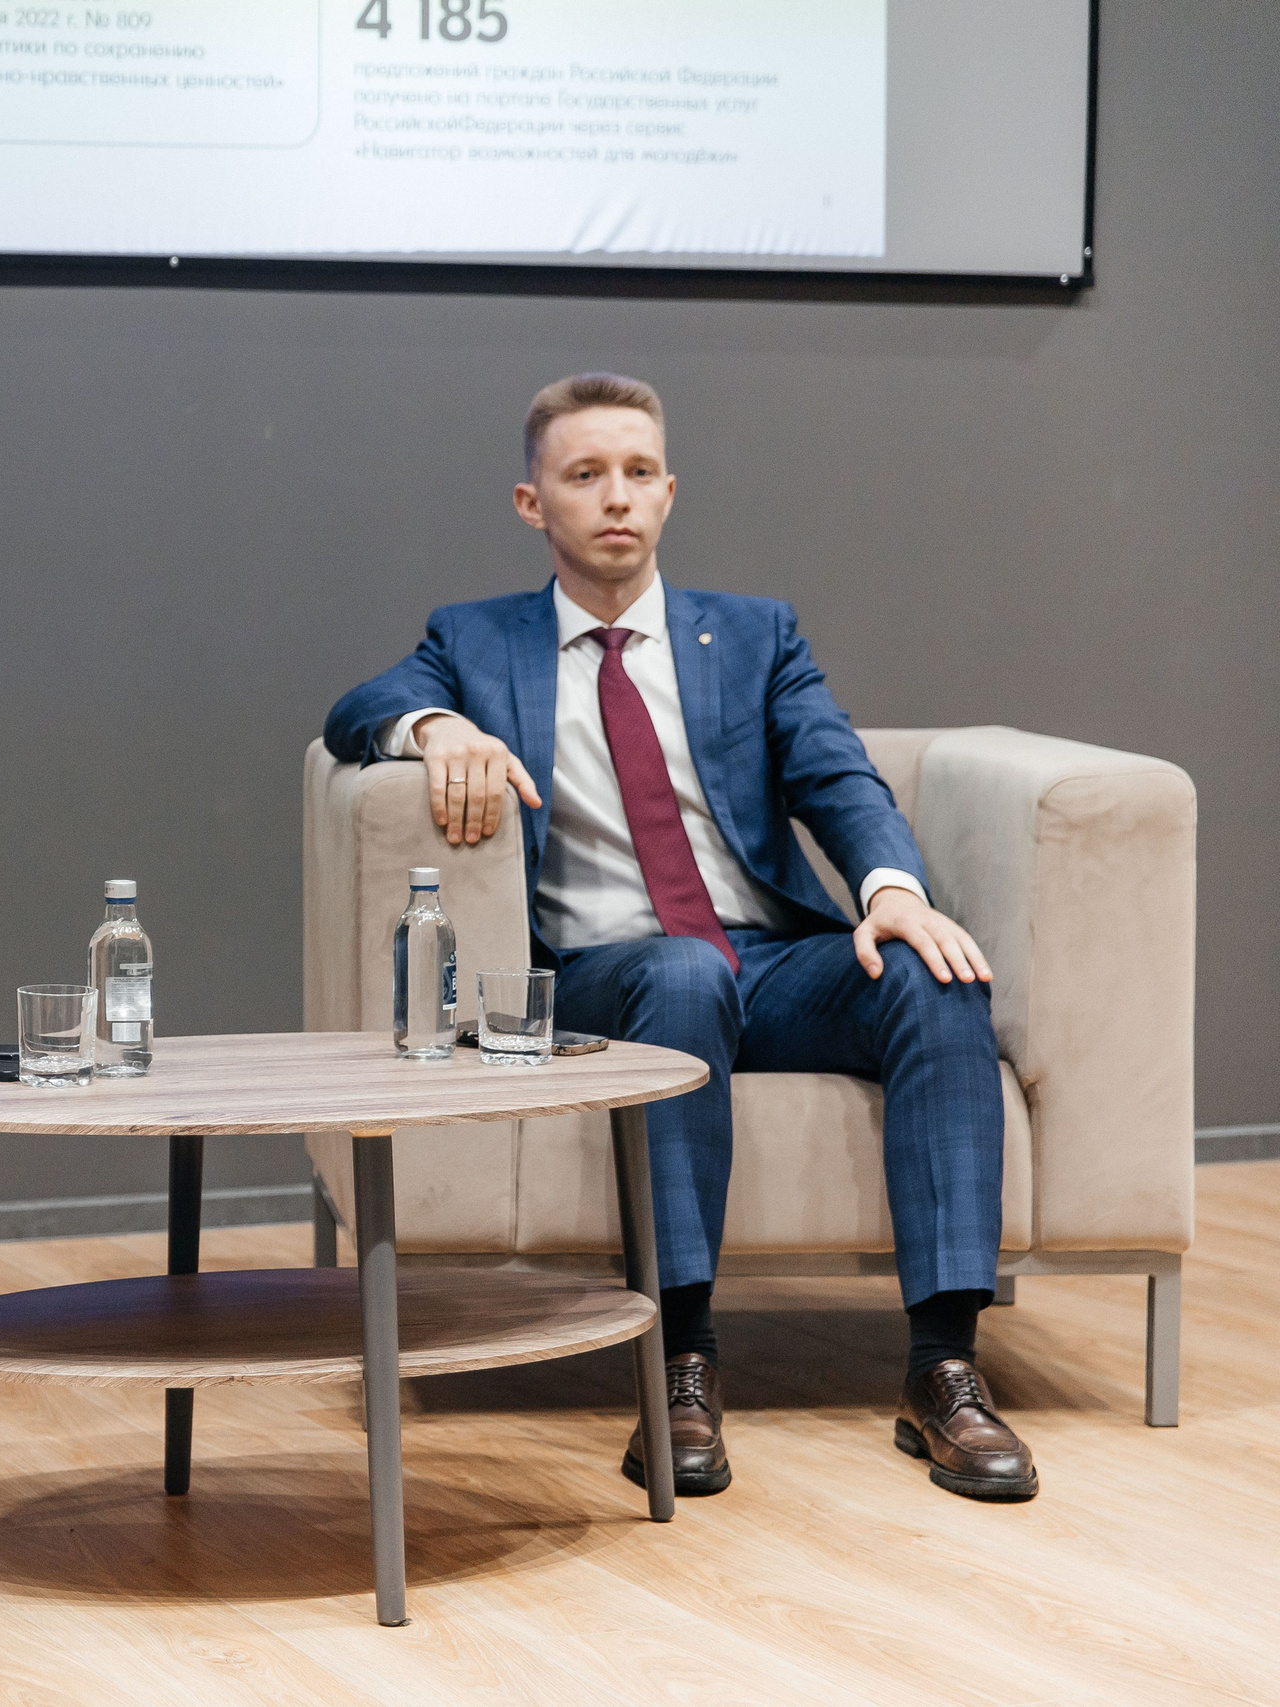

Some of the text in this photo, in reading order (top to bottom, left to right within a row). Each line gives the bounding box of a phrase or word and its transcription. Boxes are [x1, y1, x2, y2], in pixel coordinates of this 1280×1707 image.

[15, 7, 59, 28] 2022
[66, 13, 78, 29] г.
[84, 9, 110, 29] №
[116, 10, 153, 31] 809
[53, 41, 78, 57] по
[84, 42, 205, 60] сохранению
[176, 73, 284, 91] ценностей»
[354, 63, 778, 86] предложений граждан Российской Федерации
[354, 88, 759, 115] получено на портале Государственных услуг
[625, 122, 685, 136] сервис
[468, 145, 598, 162] возможностей
[604, 149, 635, 163] для
